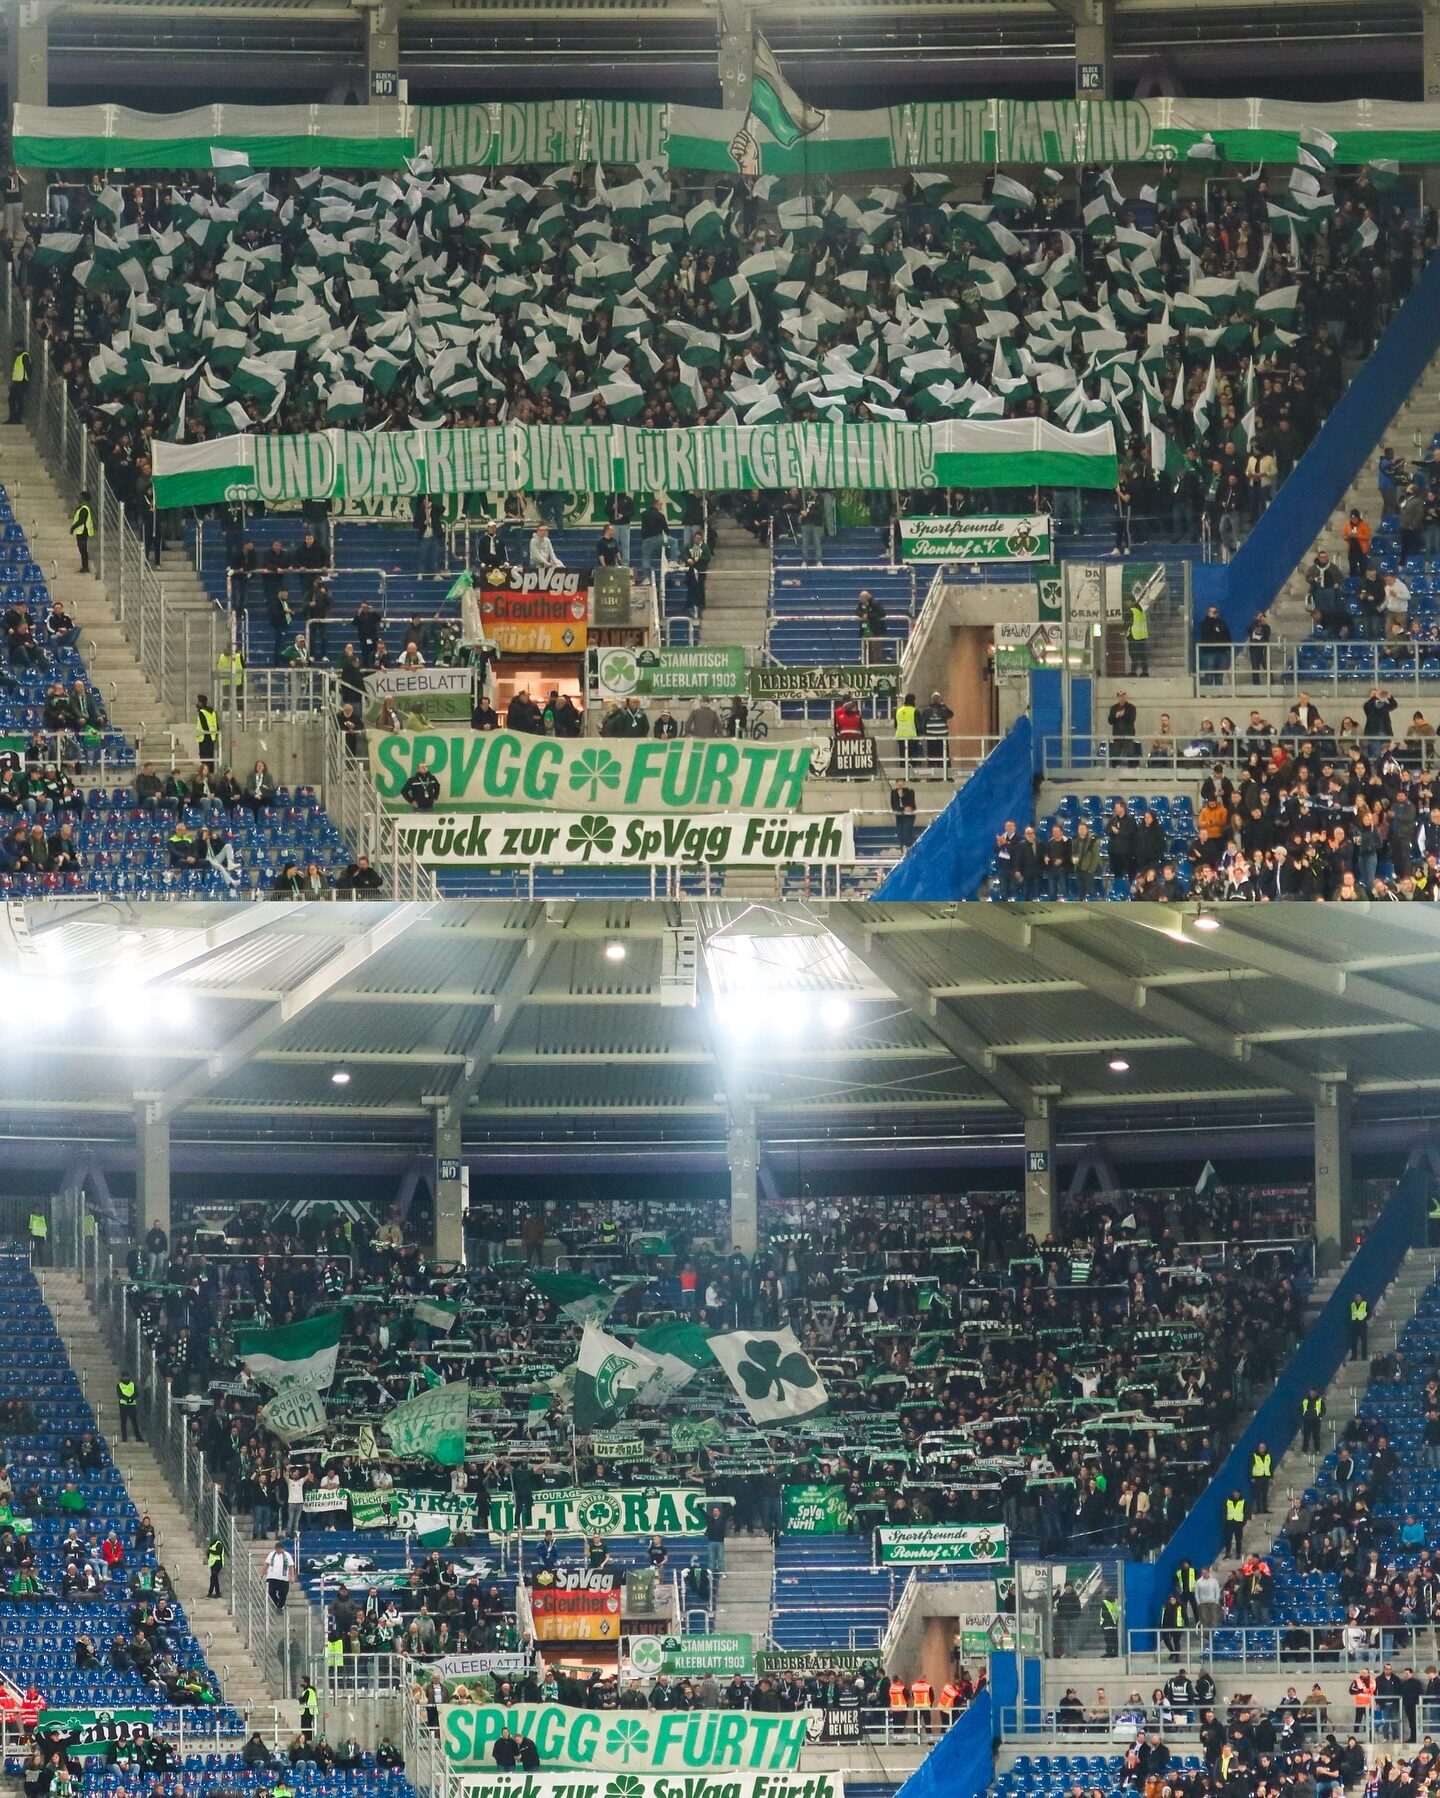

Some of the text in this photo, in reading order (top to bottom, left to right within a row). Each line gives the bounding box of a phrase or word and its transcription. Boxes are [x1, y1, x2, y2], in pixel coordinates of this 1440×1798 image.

[416, 100, 669, 167] UND DIE FAHNE
[889, 101, 986, 167] WEHT
[999, 101, 1047, 163] IM
[344, 430, 419, 498] DAS
[424, 425, 616, 495] KLEEBLATT
[624, 425, 738, 492] FÜRTH
[750, 422, 938, 490] GEWINNT!
[910, 519, 1004, 537] Sportfreunde
[912, 538, 1000, 558] Ronhof e.V.
[510, 566, 580, 596] SpVgg
[493, 596, 571, 620] Greuther
[1071, 609, 1122, 618] GRANLER
[493, 625, 551, 650] Fürth
[1001, 624, 1031, 638] FAN
[660, 653, 728, 667] STAMMTISCH
[376, 674, 467, 693] KLEEBLATT
[652, 672, 736, 688] KLEEBLATT 1903
[758, 673, 841, 690] KLEEBLATT
[837, 739, 872, 754] IMMER
[837, 754, 873, 769] BEI UNS
[375, 734, 813, 809] SPVGG FÜRTH
[500, 828, 561, 856] zur
[621, 818, 732, 862] SpVgg
[742, 816, 842, 858] Fürth
[531, 1489, 582, 1501] NTOURAGE
[398, 1511, 474, 1530] DIA
[889, 1529, 968, 1543] Sportfreunde
[890, 1544, 964, 1560] Ronhof e.V.
[555, 1568, 614, 1593] SpVgg
[682, 1640, 738, 1652] STAMMTISCH
[675, 1655, 745, 1669] KLEEBLATT 1903
[828, 1710, 858, 1723] IMMER
[828, 1723, 860, 1736] BEI UNS
[652, 1712, 807, 1769] FÜRTH
